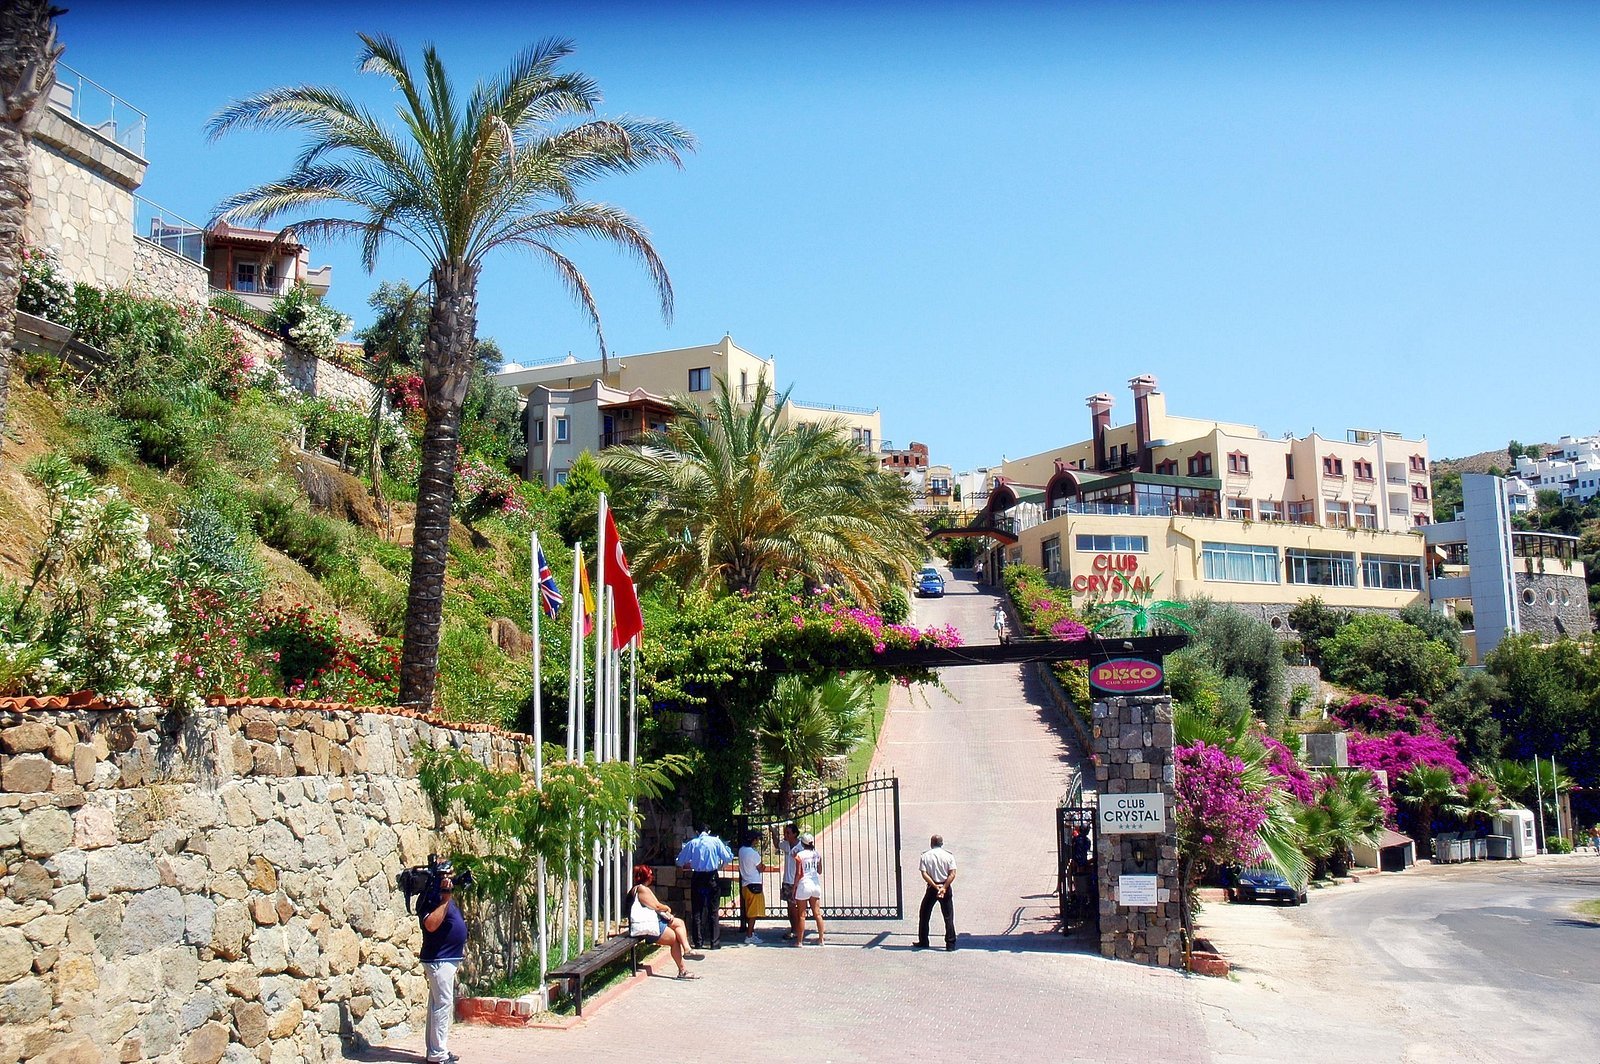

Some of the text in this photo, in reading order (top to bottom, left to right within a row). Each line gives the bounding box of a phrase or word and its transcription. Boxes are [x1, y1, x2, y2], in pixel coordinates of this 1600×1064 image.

[1093, 554, 1138, 572] CLUB
[1099, 667, 1157, 680] DISCO
[1117, 799, 1145, 809] CLUB
[1103, 810, 1160, 822] CRYSTAL
